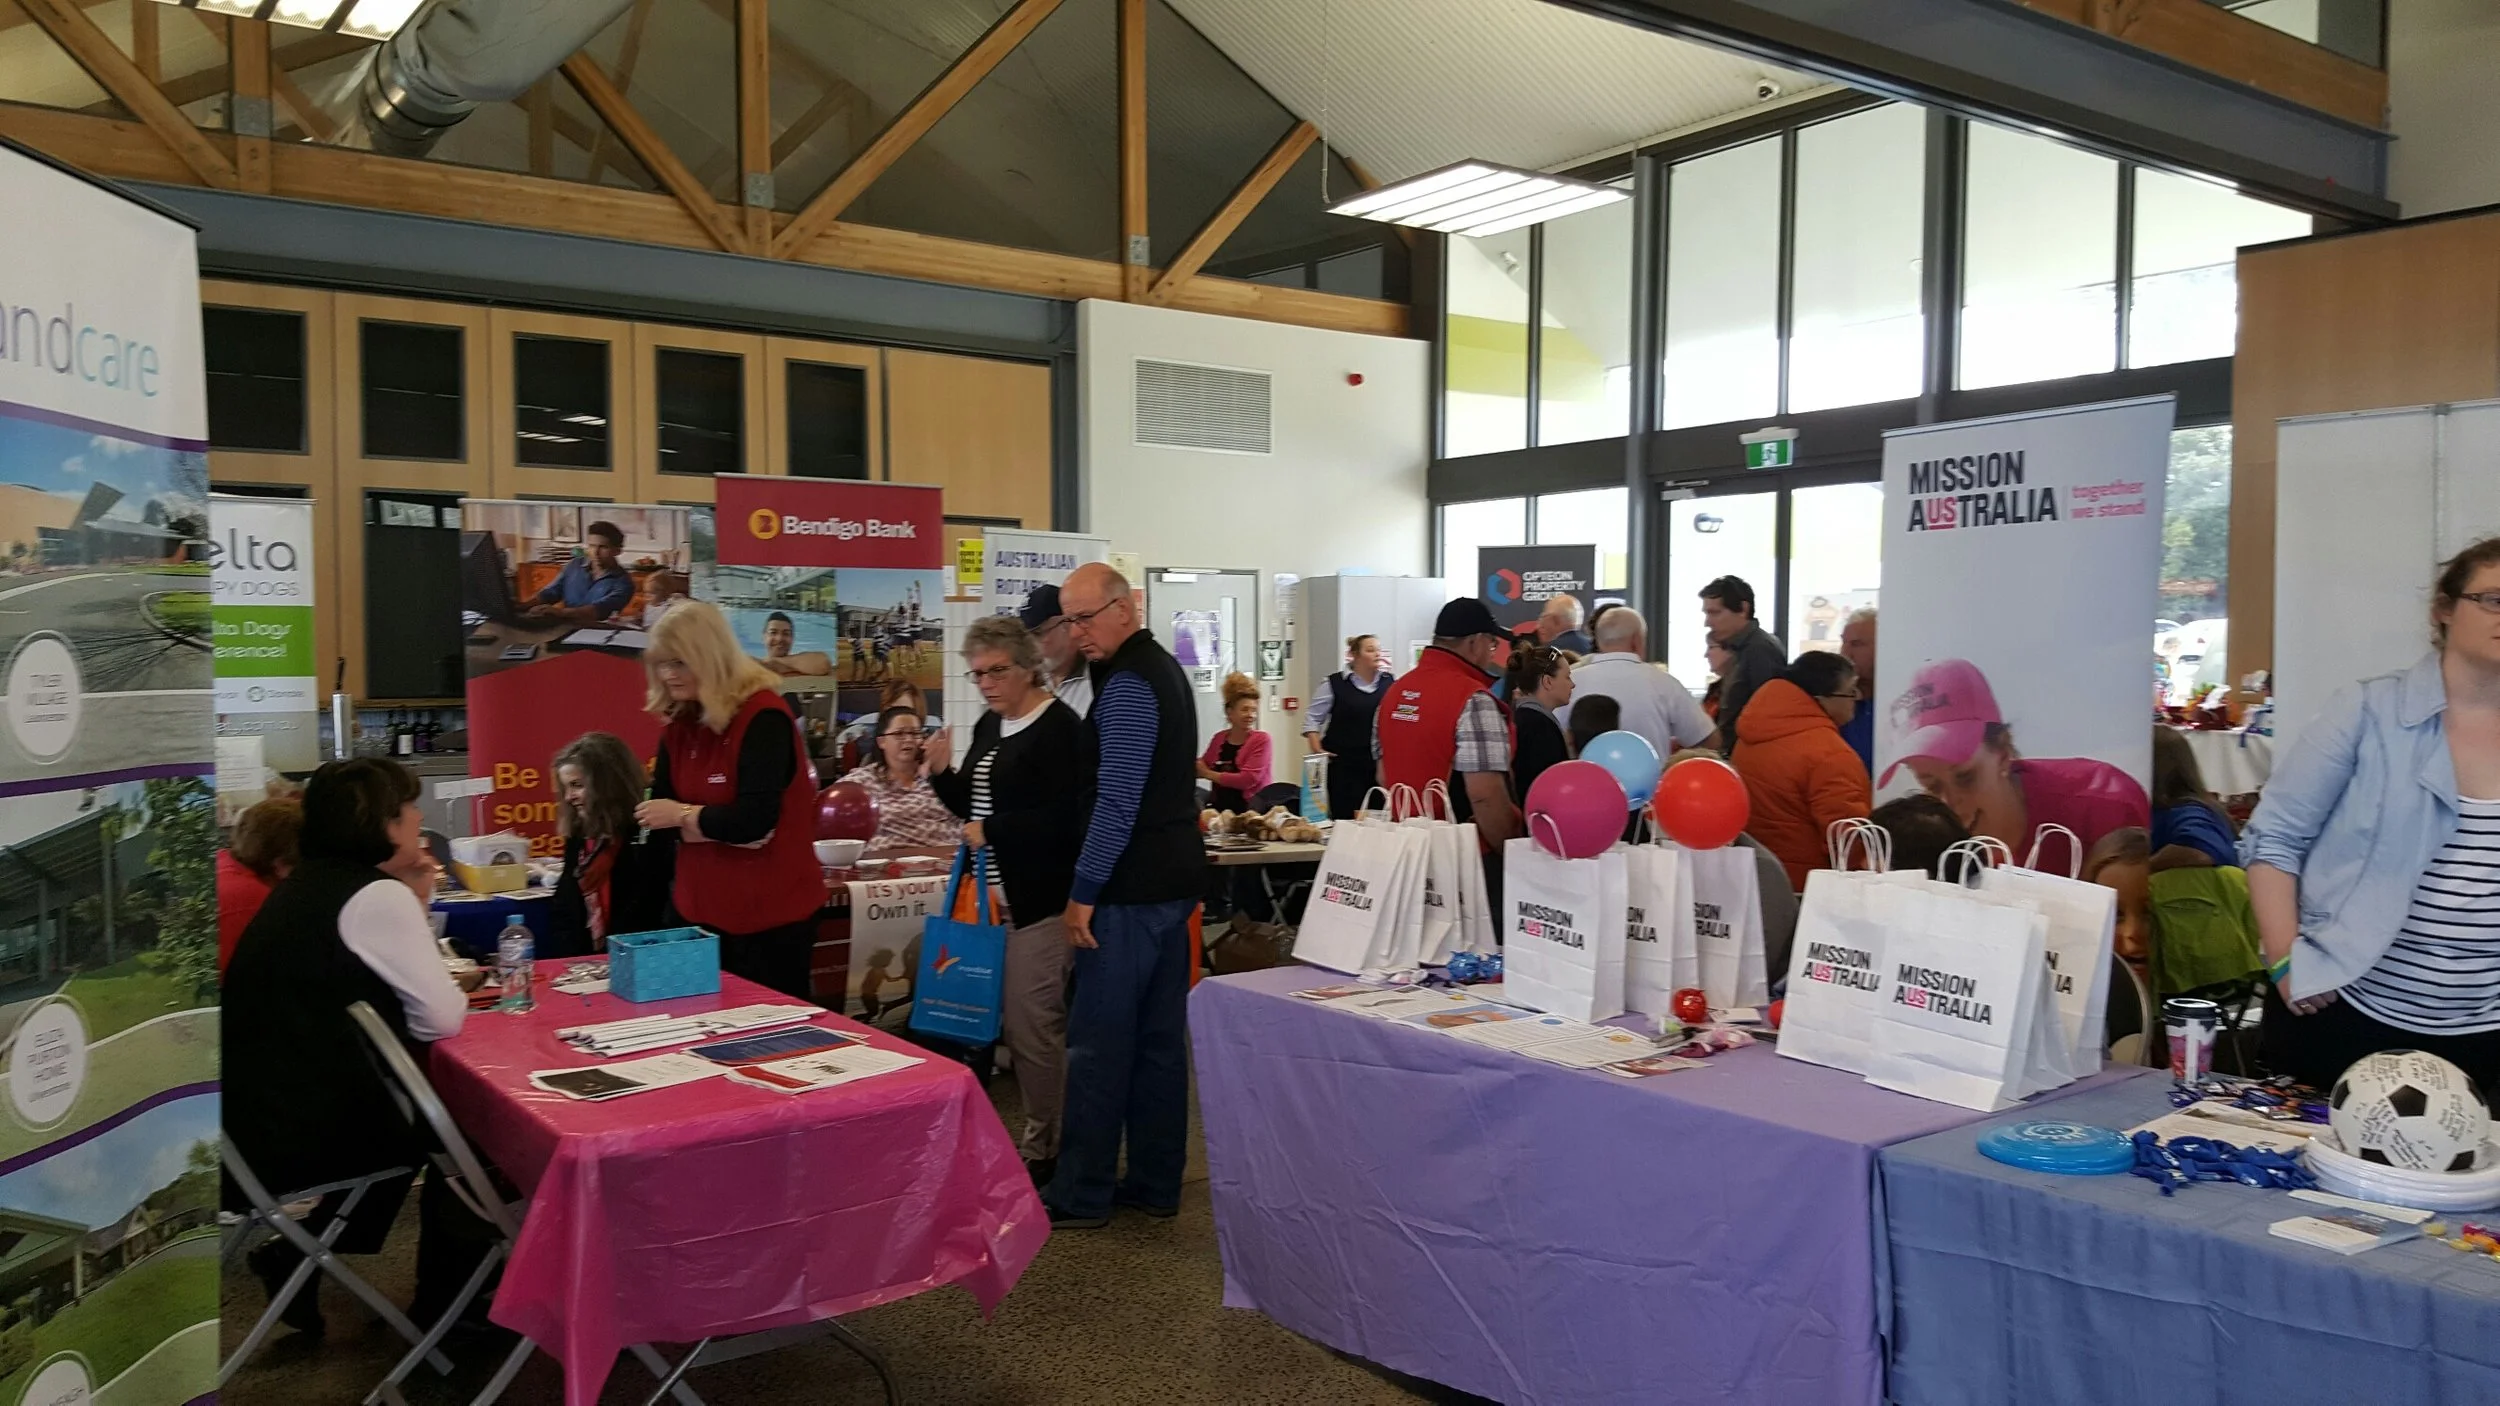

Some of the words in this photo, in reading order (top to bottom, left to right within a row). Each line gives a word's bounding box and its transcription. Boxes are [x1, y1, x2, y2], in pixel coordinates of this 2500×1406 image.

[1908, 450, 2025, 495] MISSION
[2072, 479, 2145, 502] together
[1907, 487, 2059, 532] AUSTRALIA
[2072, 507, 2094, 519] we
[2096, 500, 2146, 517] stand
[782, 515, 864, 540] Bendigo
[865, 519, 916, 538] Bank
[994, 551, 1078, 569] AUSTRALIAN
[1522, 571, 1574, 581] OPTEON
[1522, 581, 1586, 591] PROPERTY
[494, 762, 540, 789] Be
[866, 883, 892, 898] It's
[896, 880, 935, 900] your
[1326, 872, 1369, 894] MISSION
[1320, 887, 1373, 911] AUSTRALIA
[867, 903, 908, 920] Own
[1518, 901, 1573, 928] MISSION
[1517, 918, 1585, 950] AUSTRALIA
[1807, 942, 1872, 969] MISSION
[1897, 963, 1977, 998] MISSION
[1893, 985, 1992, 1025] AUSTRALIA
